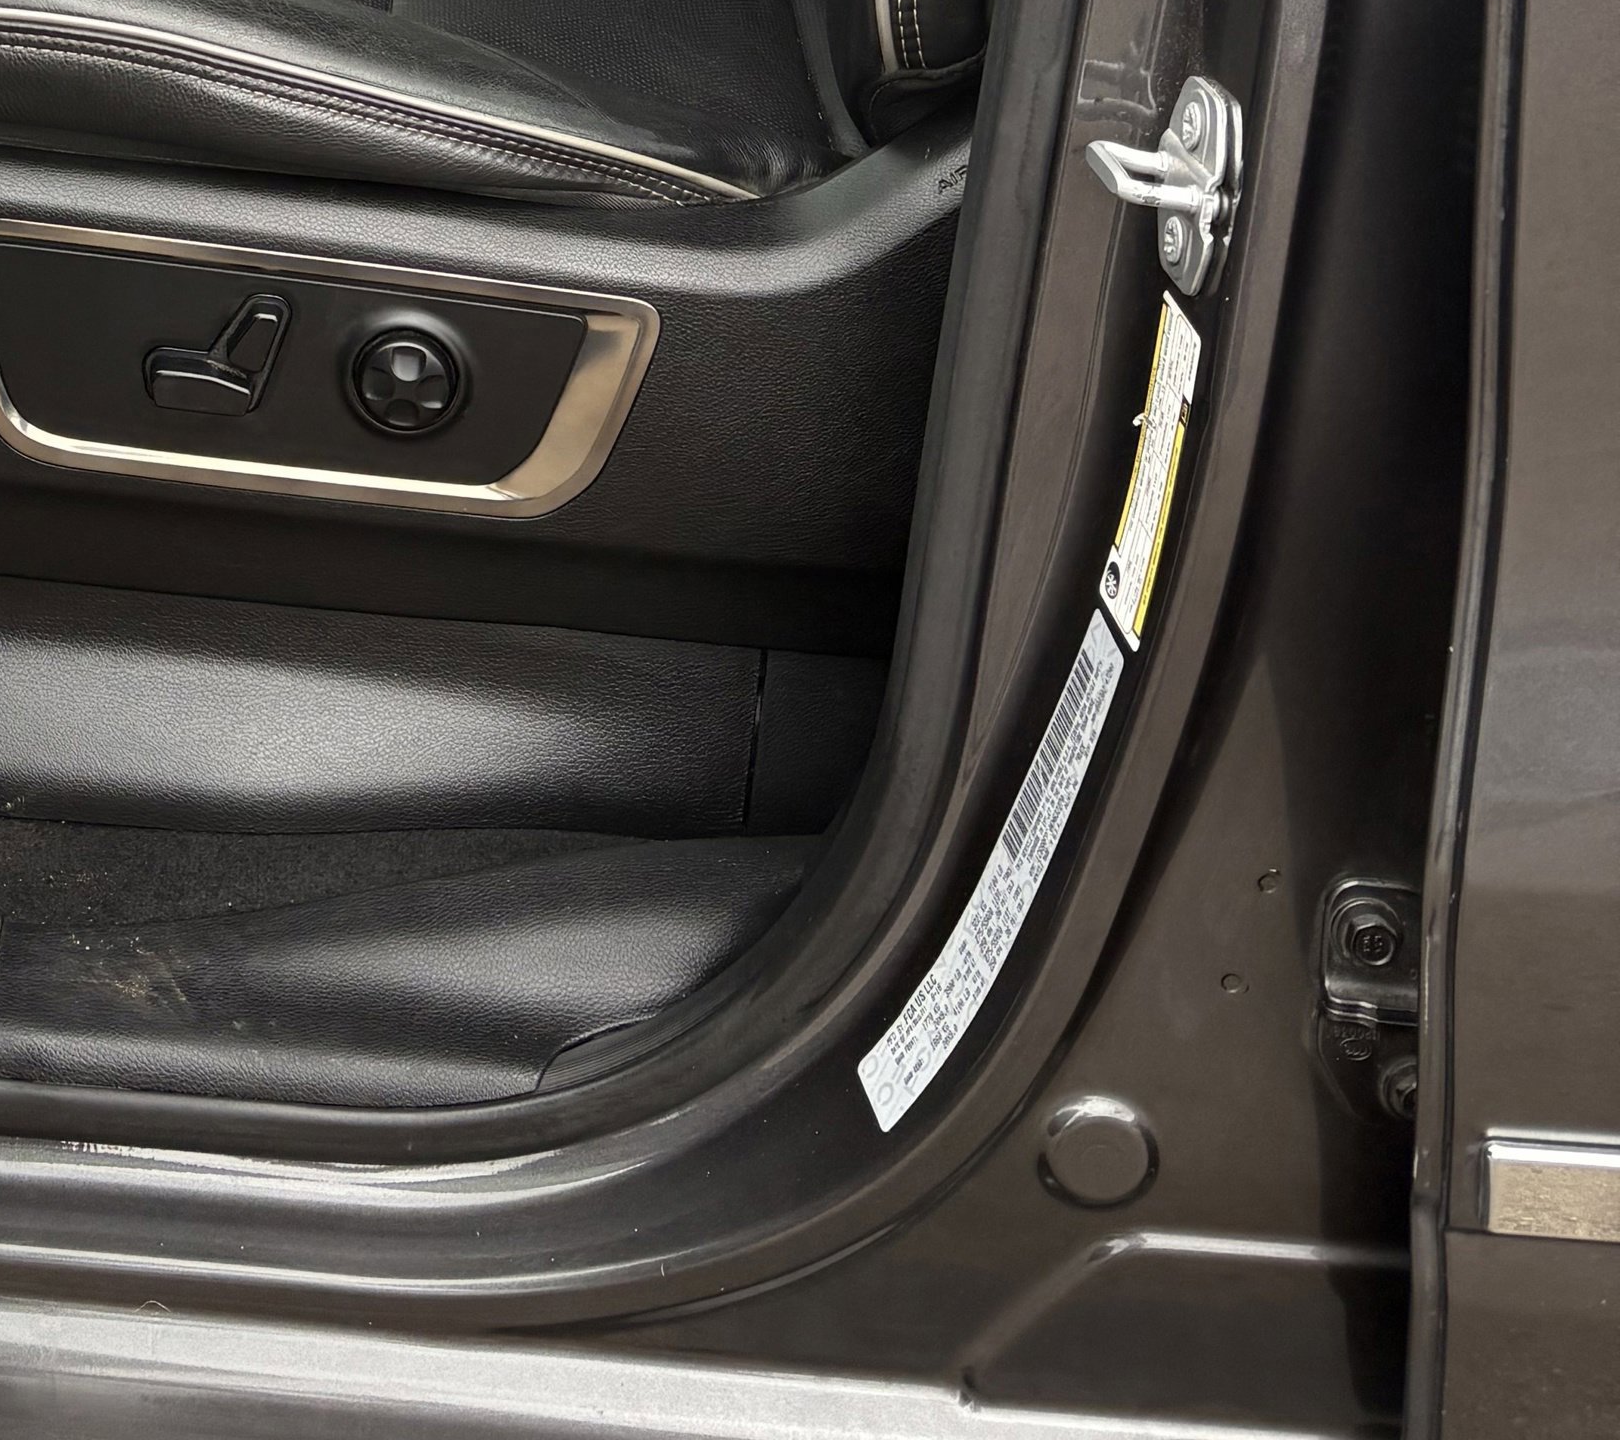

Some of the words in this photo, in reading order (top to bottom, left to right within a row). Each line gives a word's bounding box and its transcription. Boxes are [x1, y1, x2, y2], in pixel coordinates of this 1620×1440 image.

[902, 1002, 916, 1025] FCA
[914, 989, 925, 1007] US
[924, 974, 936, 995] LLC
